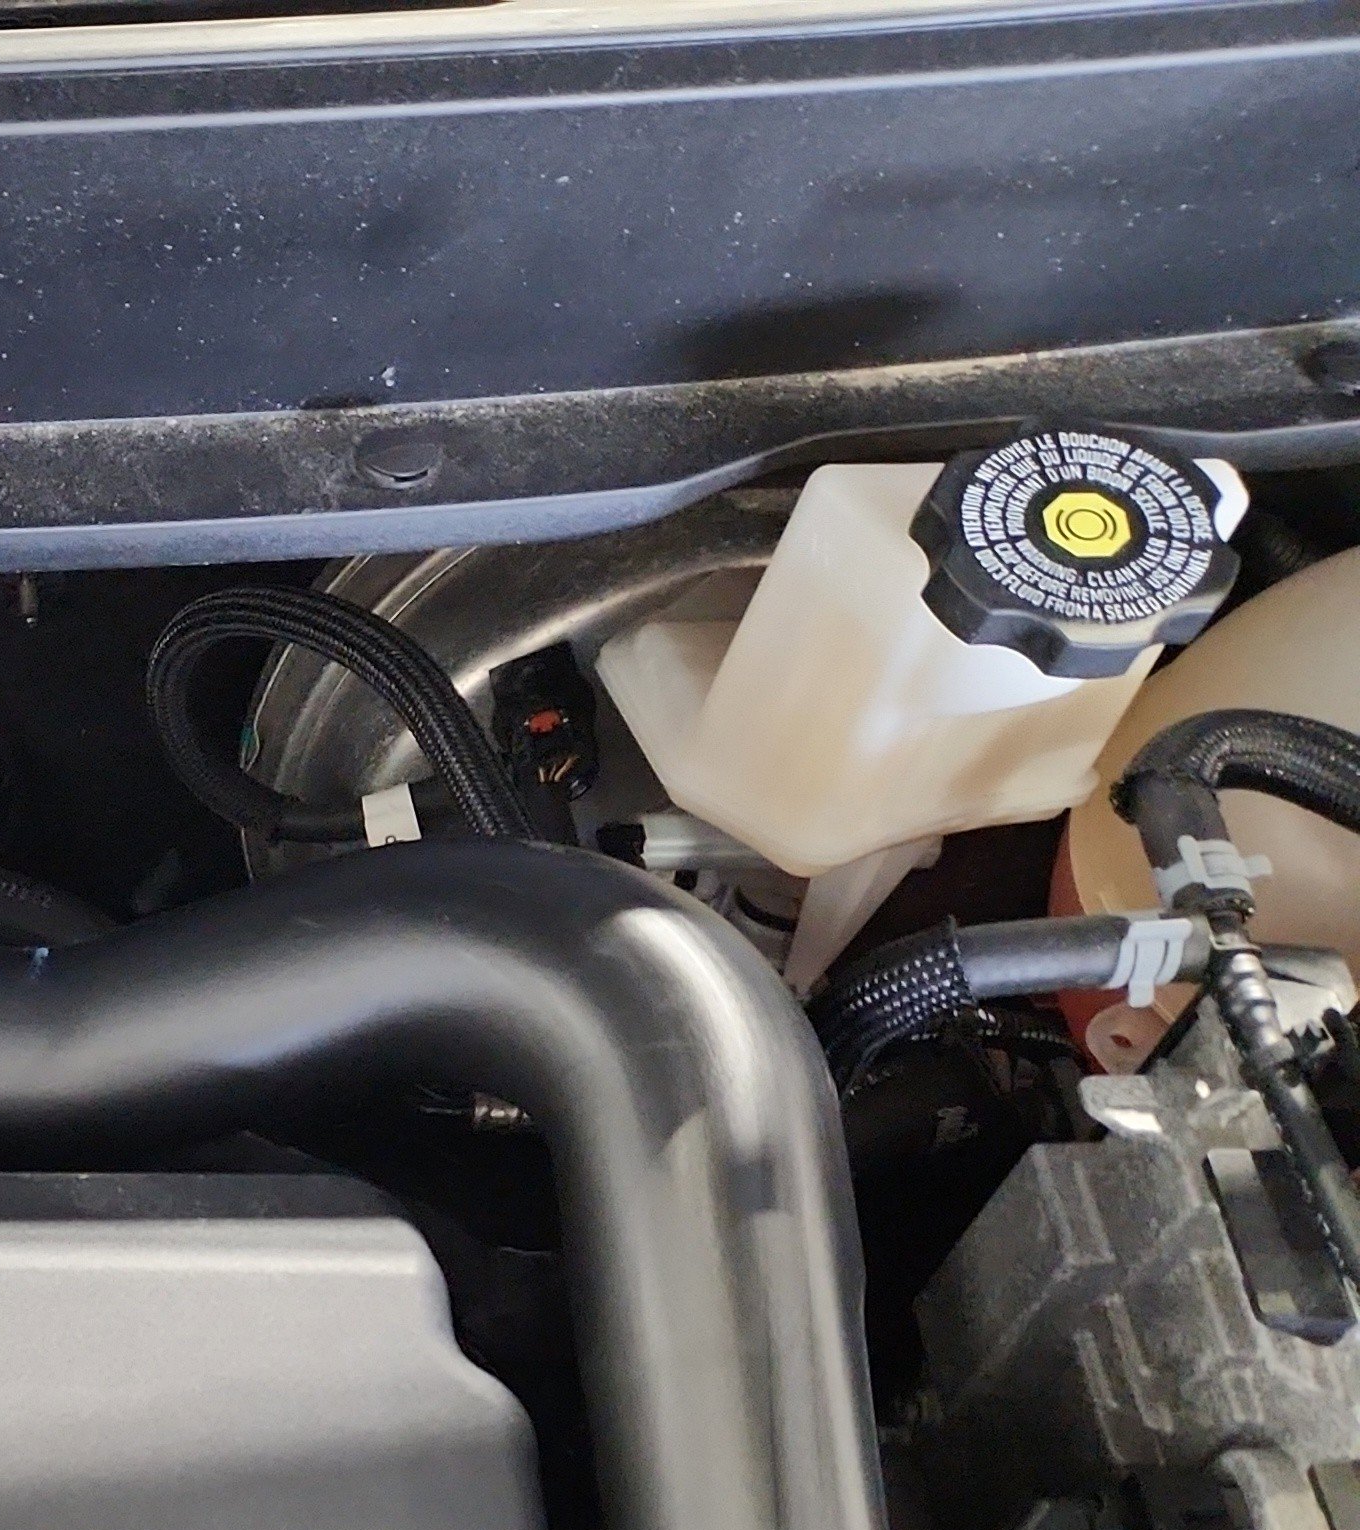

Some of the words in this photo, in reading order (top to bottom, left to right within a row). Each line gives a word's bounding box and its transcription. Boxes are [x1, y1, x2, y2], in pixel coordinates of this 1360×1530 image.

[974, 438, 1037, 483] NETTOYER
[1035, 433, 1057, 450] LE
[1058, 431, 1131, 458] BOUCHON
[1129, 448, 1178, 480] AVANT
[1168, 477, 1193, 497] LA
[1010, 456, 1040, 478] QUE
[1038, 450, 1061, 466] DU
[1063, 448, 1121, 470] LIQUIDE
[1121, 461, 1144, 480] DE
[1140, 474, 1179, 508] FREIN
[1005, 472, 1047, 536] PROVENANT
[1045, 464, 1083, 483] D'UN
[1086, 464, 1134, 492] BIDON
[994, 542, 1023, 565] CAP
[1013, 561, 1070, 598] BEFORE
[1145, 566, 1176, 589] USE
[1163, 540, 1190, 571] ONLY
[1087, 565, 1137, 587] CLEAN
[1129, 537, 1168, 576] FILLER
[1001, 574, 1046, 607] FLUID
[1044, 595, 1090, 619] FROM
[1092, 604, 1105, 621] A
[1104, 596, 1162, 621] SEALED
